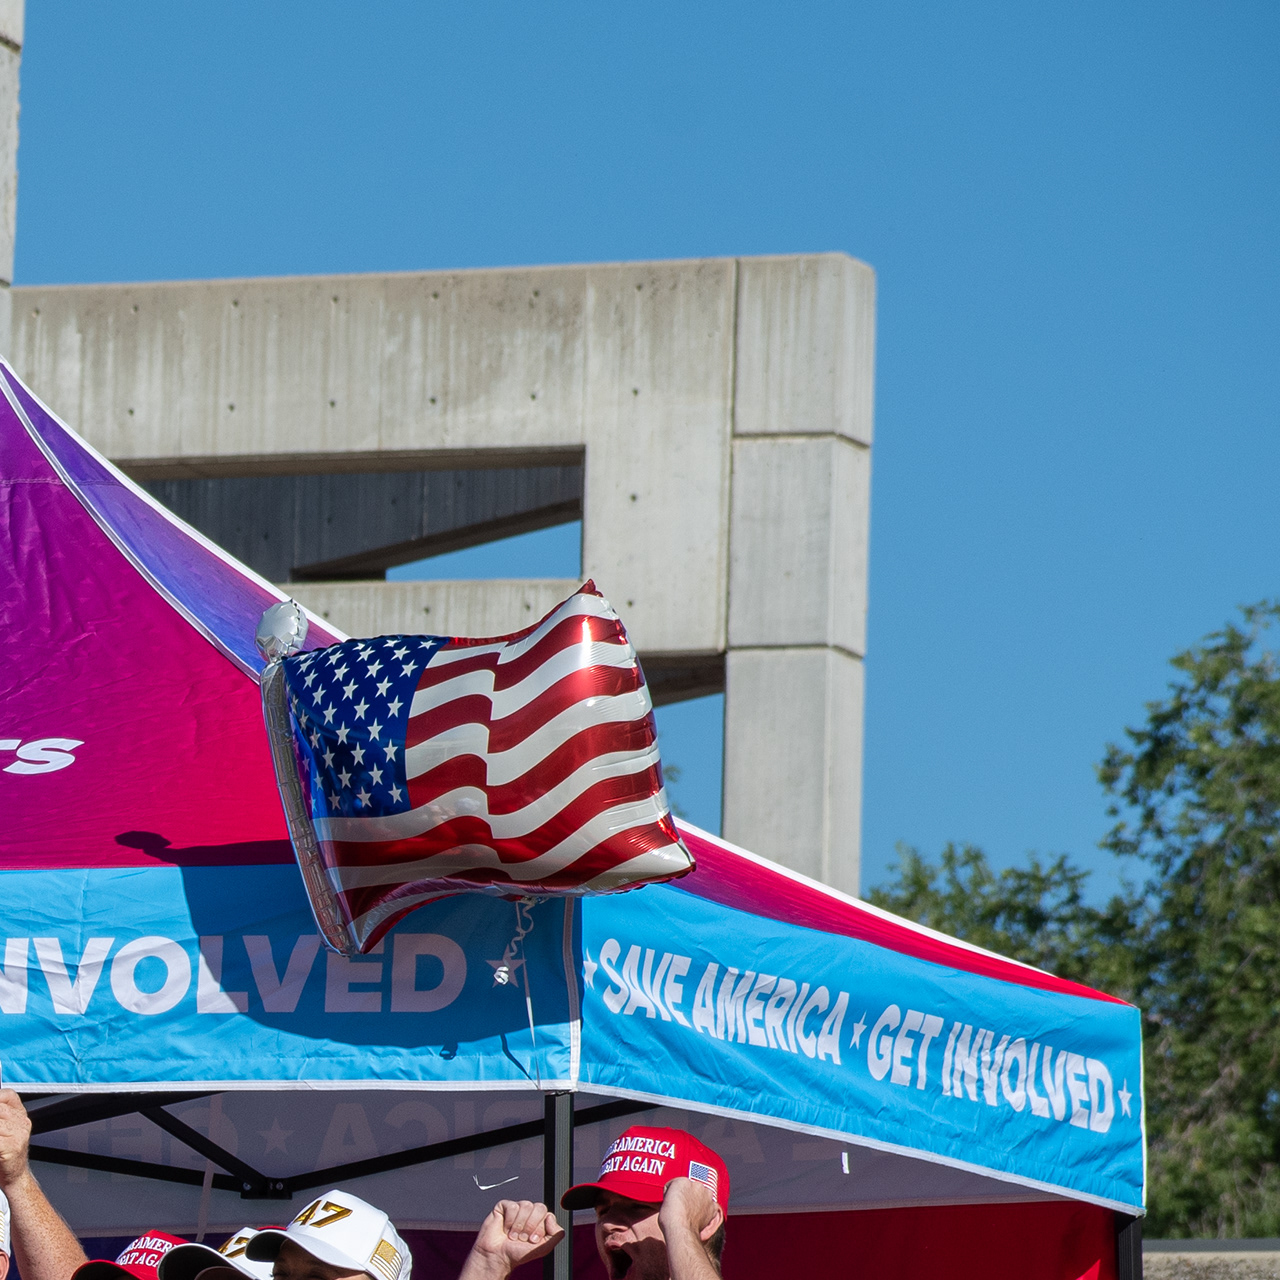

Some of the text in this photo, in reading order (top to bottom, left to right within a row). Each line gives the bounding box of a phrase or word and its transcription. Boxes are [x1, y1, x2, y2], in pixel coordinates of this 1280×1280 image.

[599, 938, 1114, 1134] SAVE AMERICA GET INVOLVED
[620, 1137, 675, 1159] AMERICA
[620, 1156, 665, 1175] AGAIN
[293, 1200, 353, 1228] 47
[134, 1237, 177, 1252] AMER
[217, 1236, 250, 1258] 47
